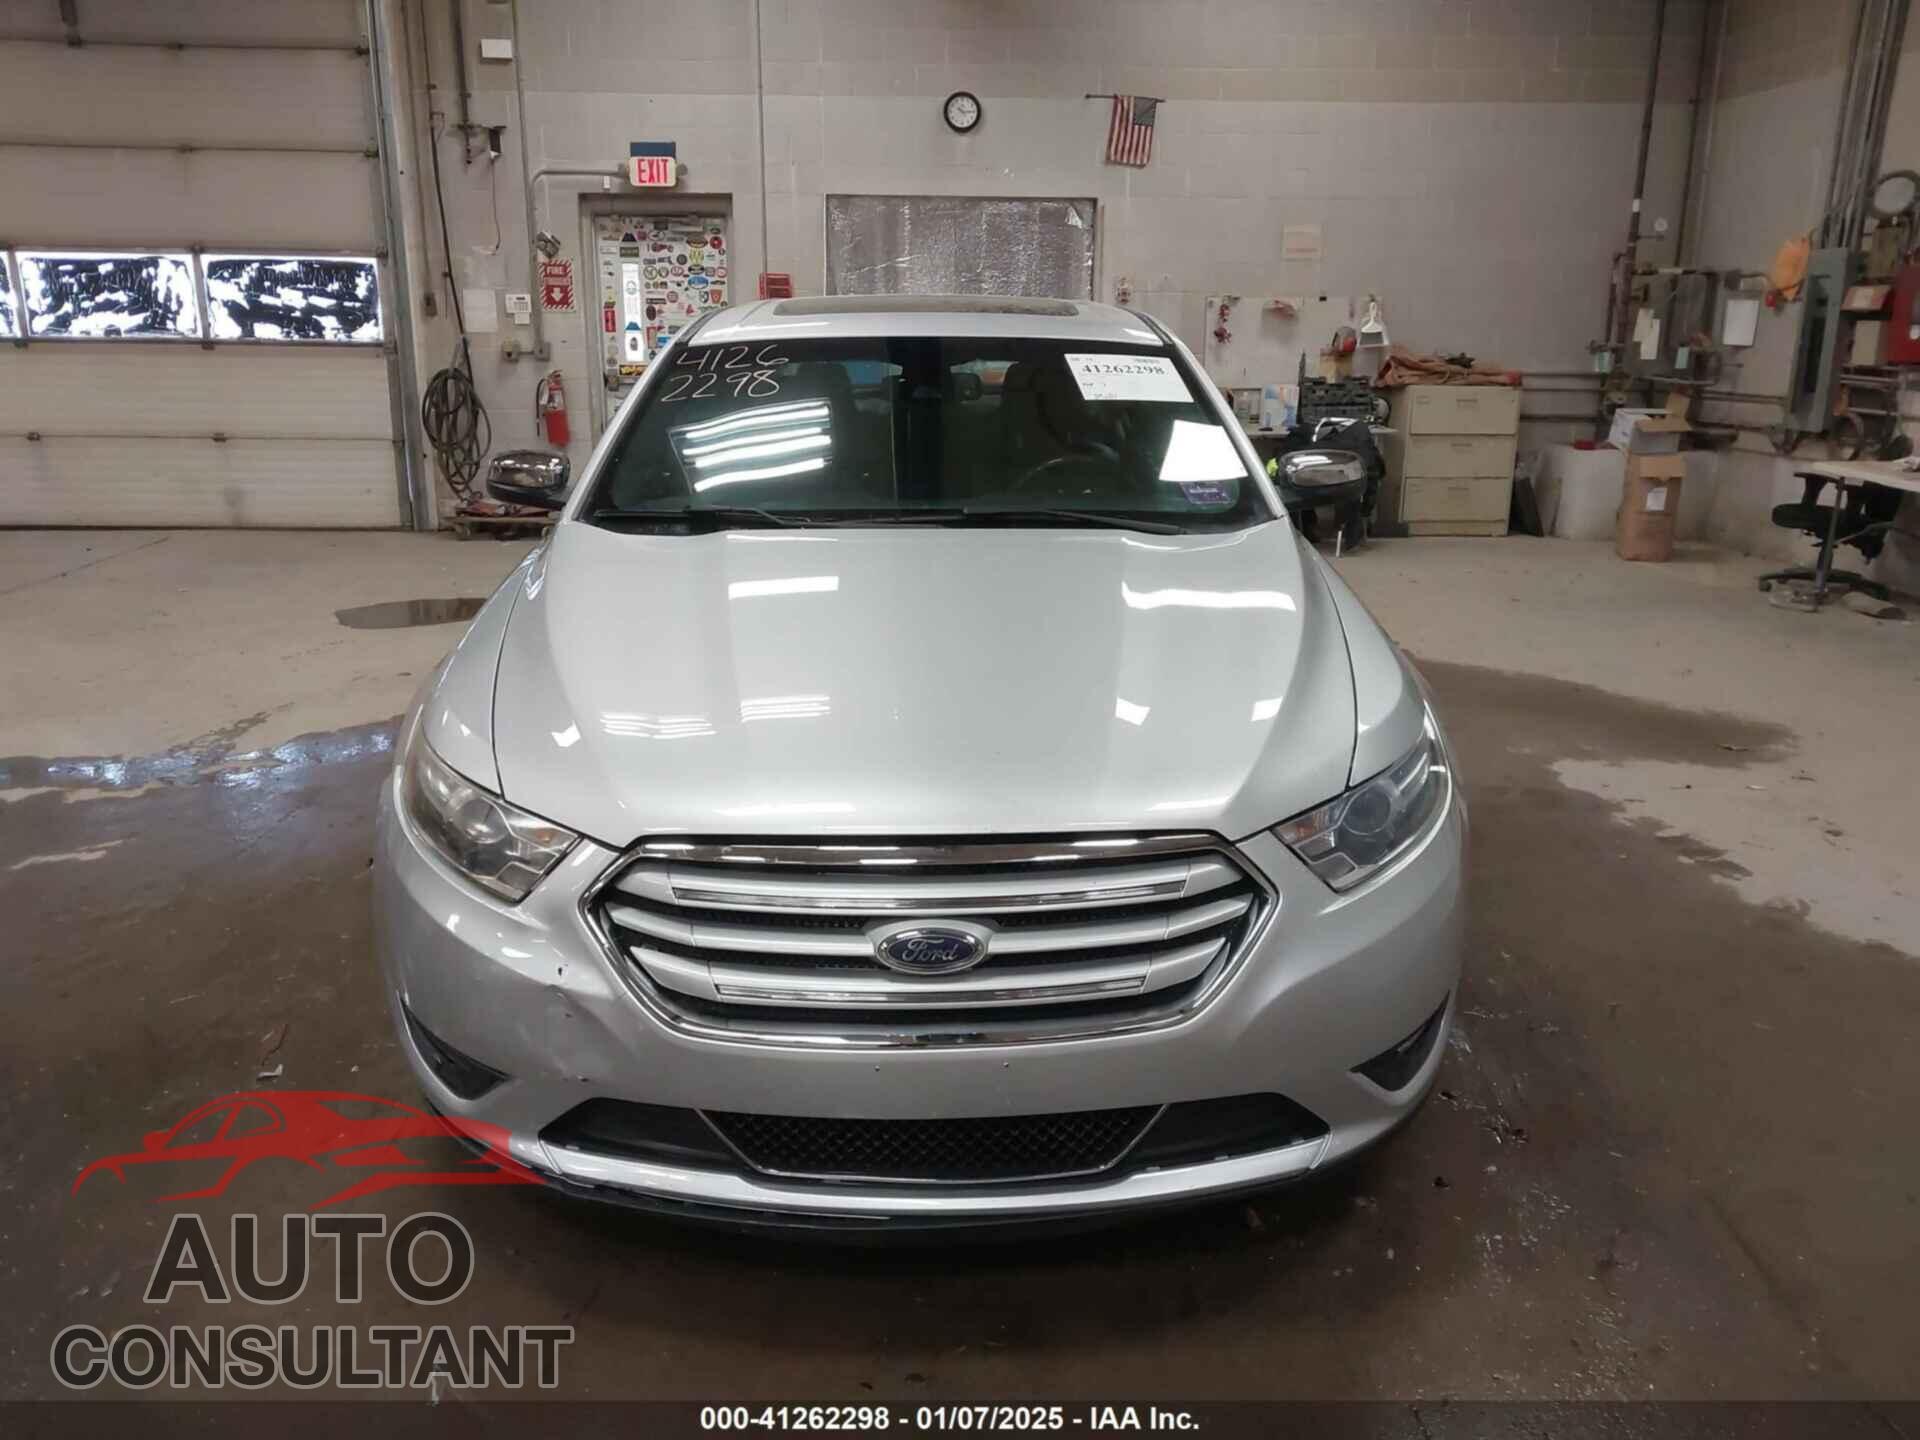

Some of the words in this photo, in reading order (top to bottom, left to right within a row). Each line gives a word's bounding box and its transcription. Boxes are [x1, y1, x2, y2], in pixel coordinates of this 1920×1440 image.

[637, 158, 670, 185] EXIT
[546, 266, 567, 275] FIRE
[676, 344, 789, 371] 4126
[1081, 364, 1165, 375] 41262298
[660, 369, 780, 402] 2298
[901, 938, 958, 962] Ford
